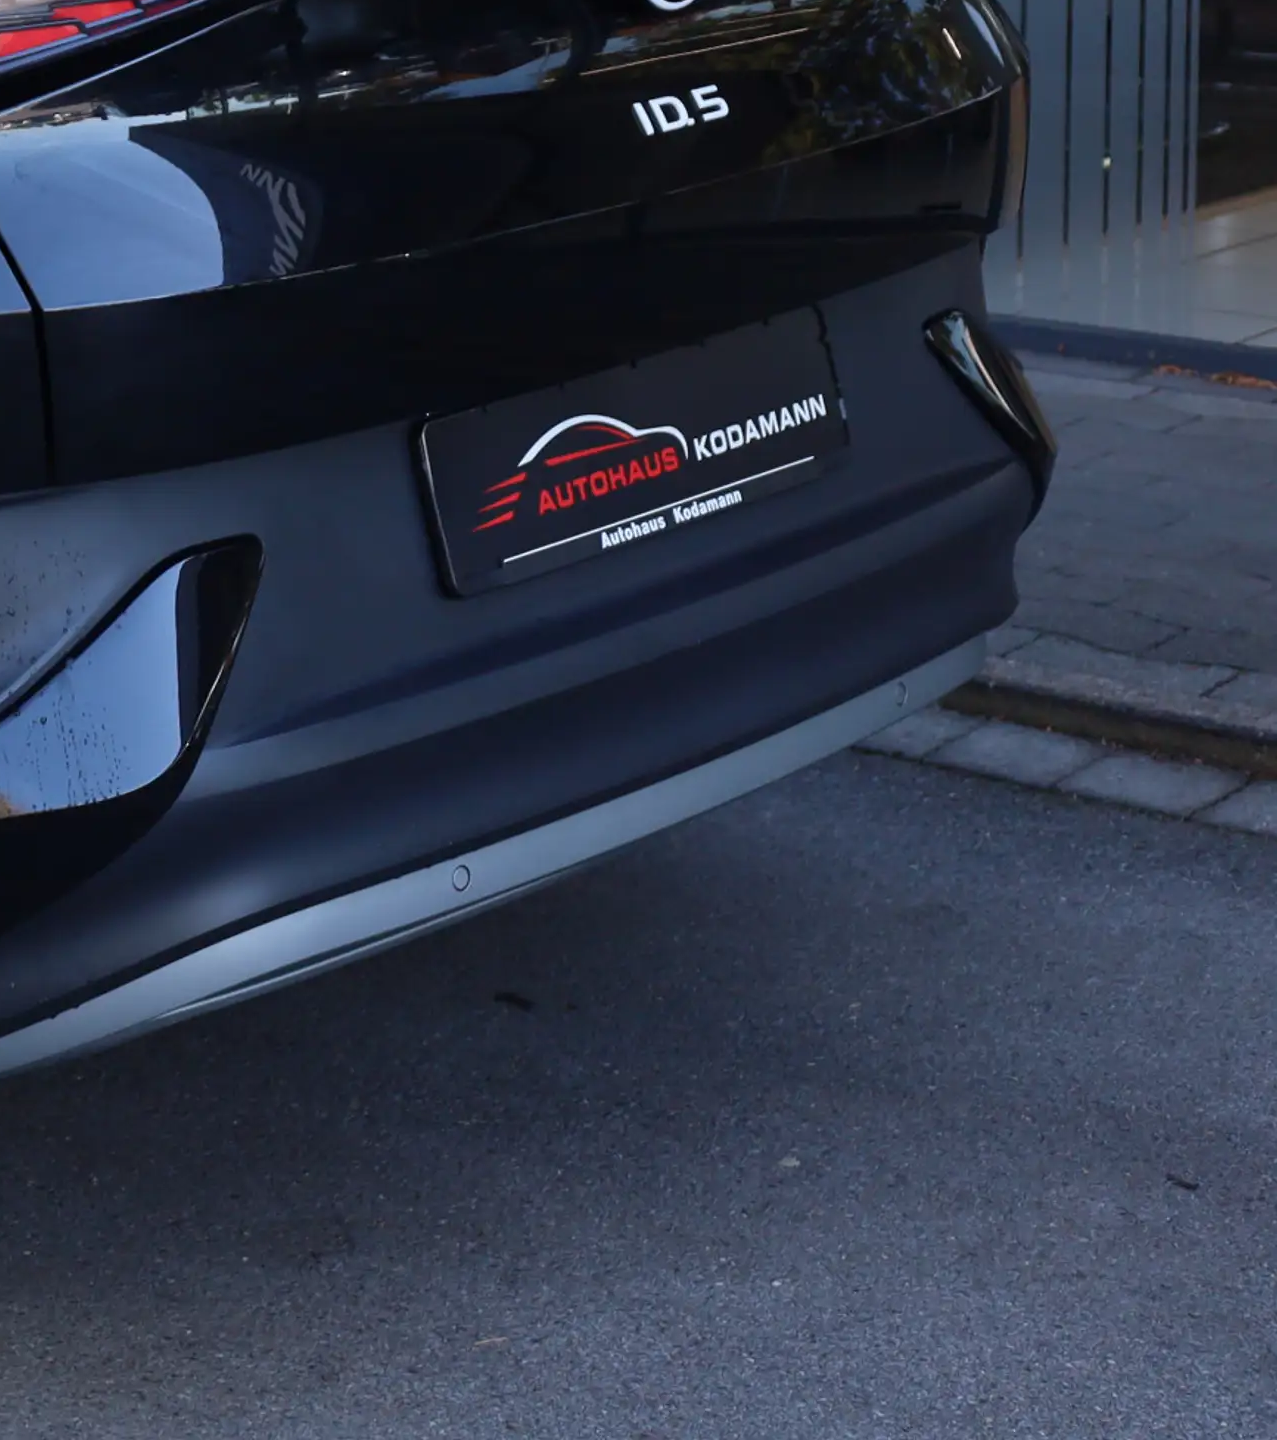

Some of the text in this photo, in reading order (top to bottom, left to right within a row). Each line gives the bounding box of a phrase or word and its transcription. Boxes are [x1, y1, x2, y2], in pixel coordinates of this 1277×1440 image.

[633, 84, 729, 136] ID.5
[538, 394, 826, 515] AUTOHAUS KODAMANN
[601, 489, 742, 549] Autohaus Kodamann
